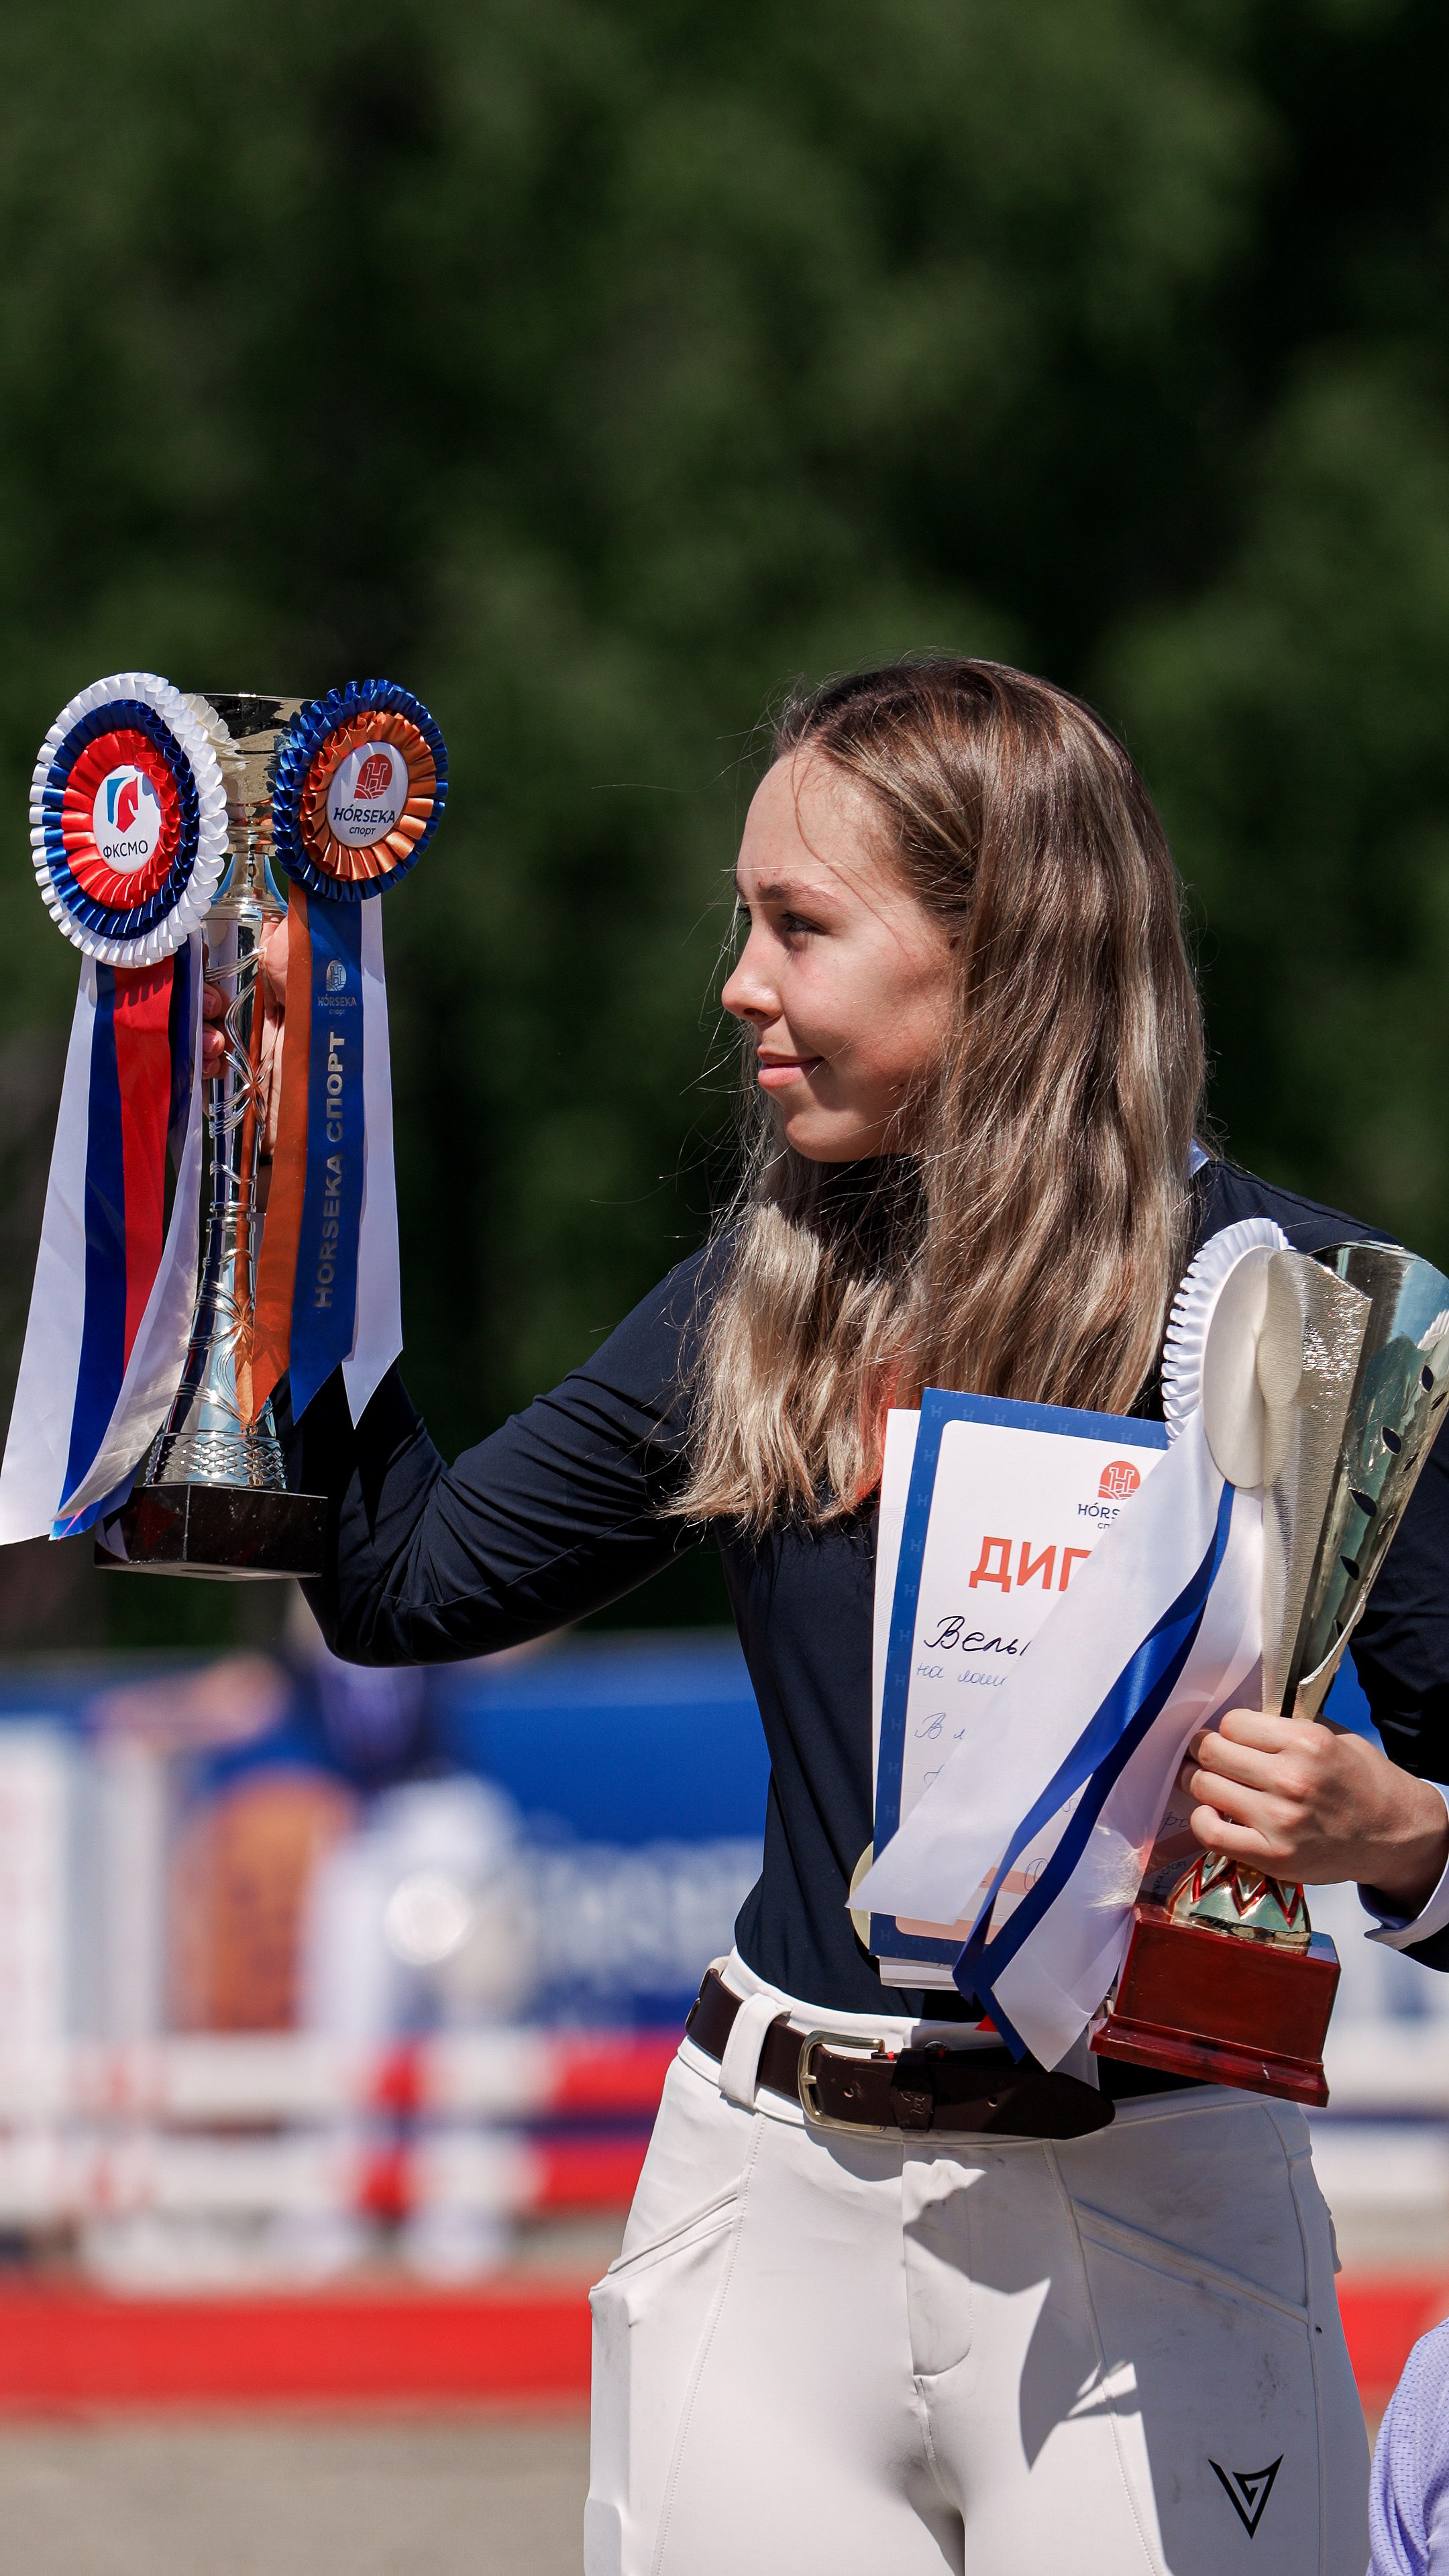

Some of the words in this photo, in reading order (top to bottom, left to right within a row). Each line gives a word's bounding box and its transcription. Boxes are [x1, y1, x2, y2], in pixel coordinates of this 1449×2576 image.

[333, 804, 396, 824] HÓRSEKA
[349, 826, 376, 837] спорт
[103, 840, 148, 859] ФКСМО
[317, 994, 357, 1007] HÓRSEKA
[329, 1008, 345, 1016] спорт
[326, 1031, 345, 1142] СПОРТ
[313, 1153, 343, 1308] HORSEKA
[1077, 1502, 1120, 1519] HÓRS
